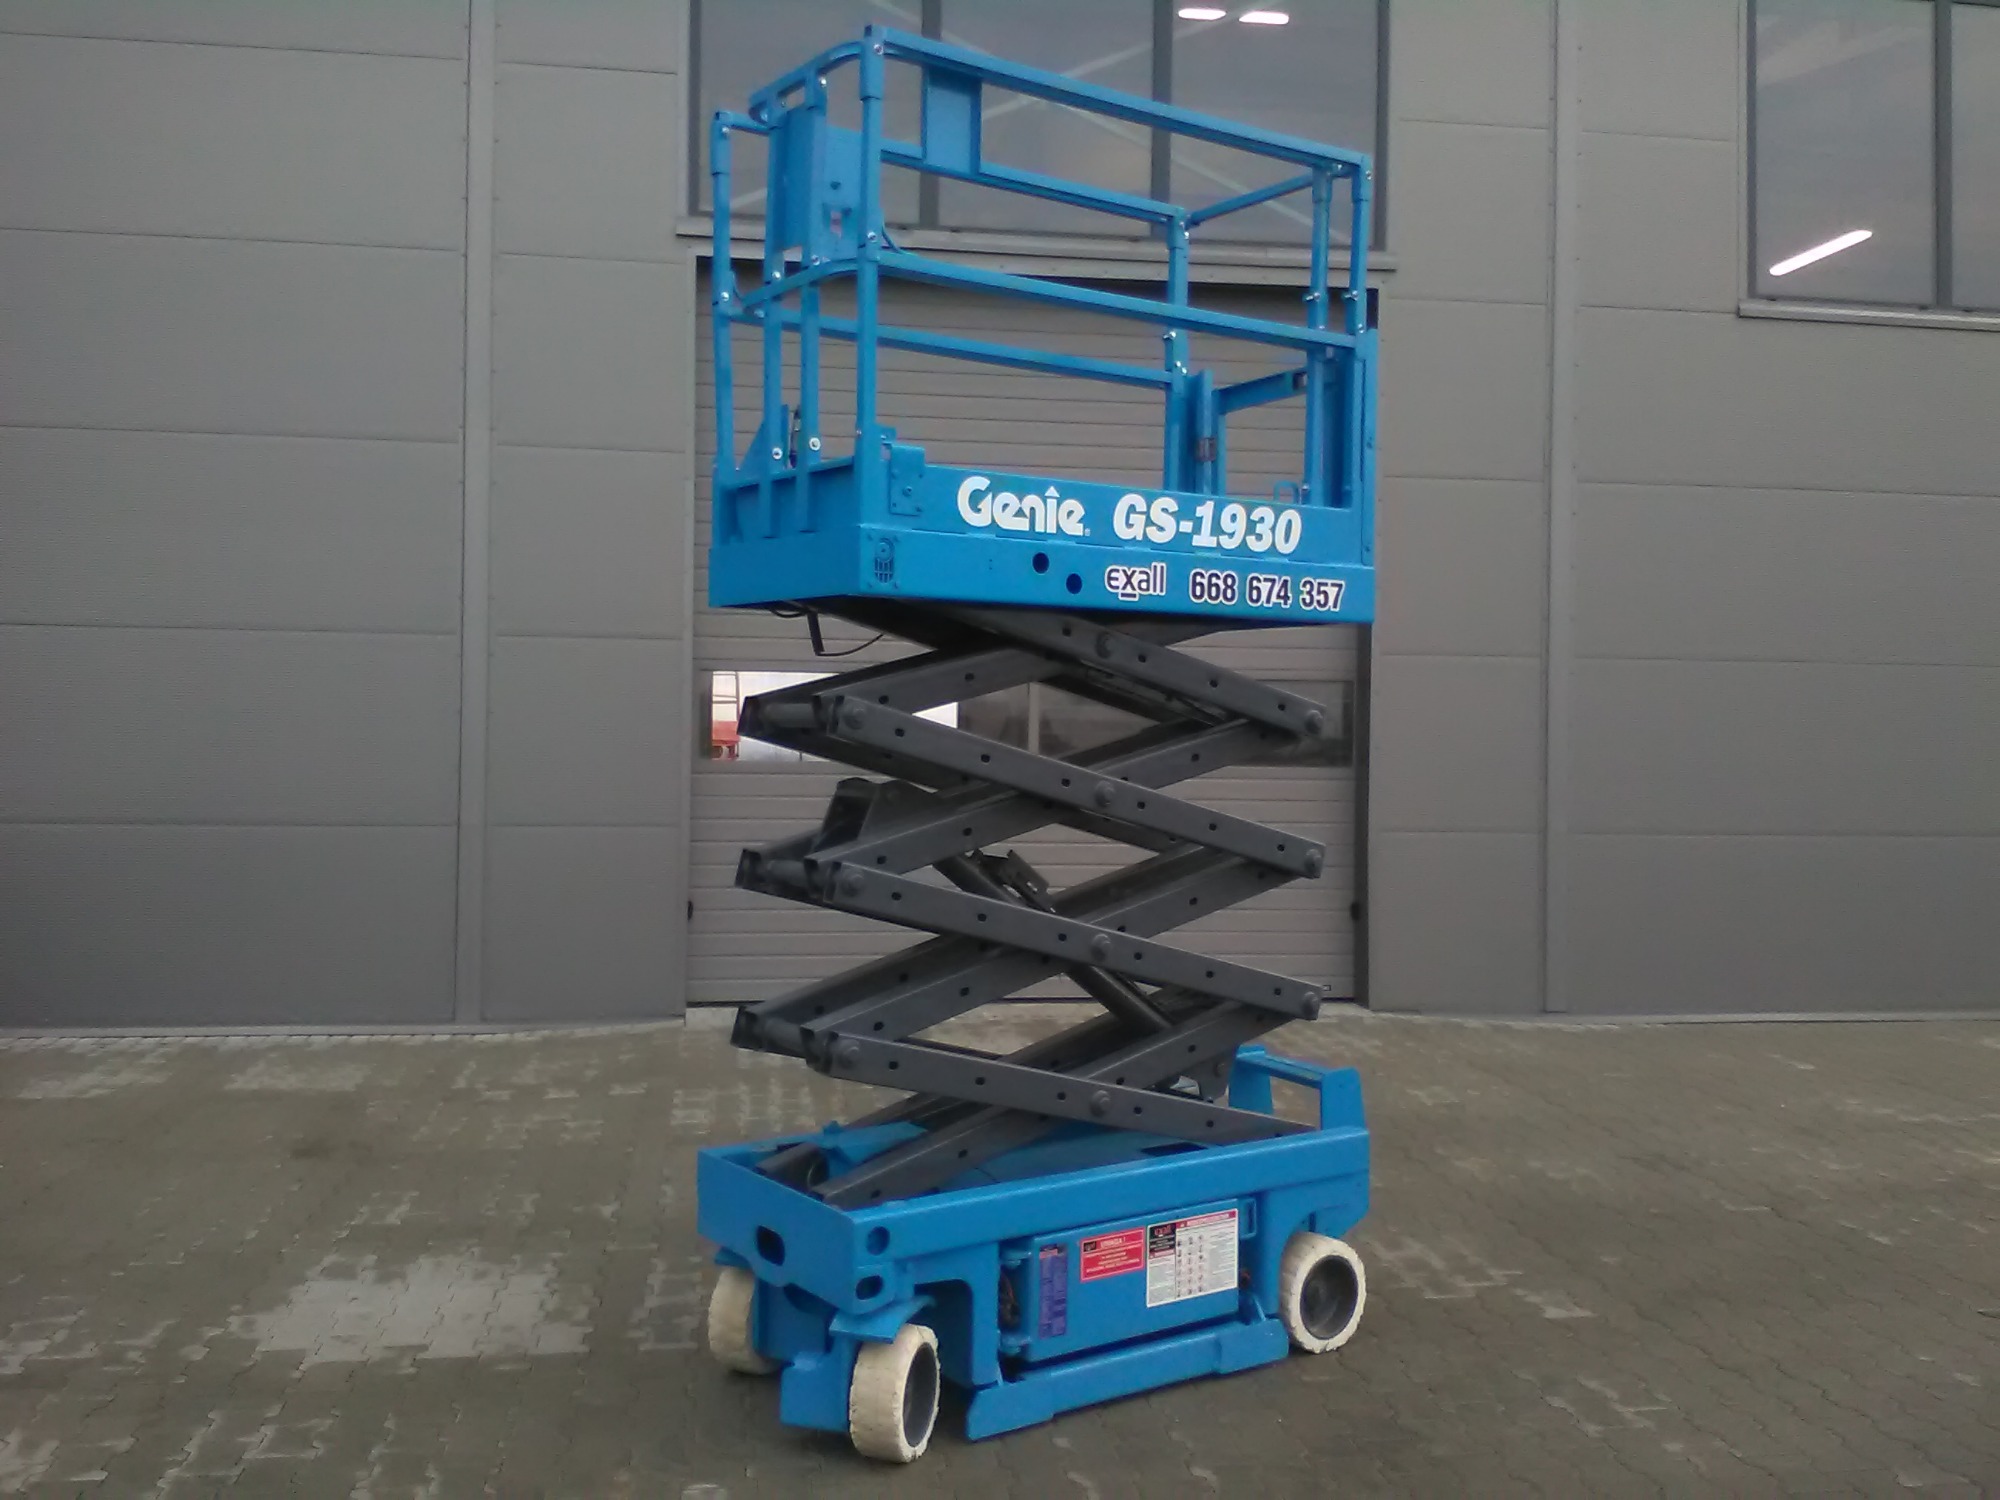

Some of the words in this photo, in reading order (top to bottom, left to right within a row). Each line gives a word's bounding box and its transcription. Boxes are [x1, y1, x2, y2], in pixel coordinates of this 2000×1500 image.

[957, 475, 1085, 536] Genie
[1113, 493, 1302, 555] GS-1930
[1107, 564, 1165, 598] exall
[1191, 571, 1236, 604] 668
[1248, 577, 1290, 606] 674
[1301, 580, 1343, 611] 357
